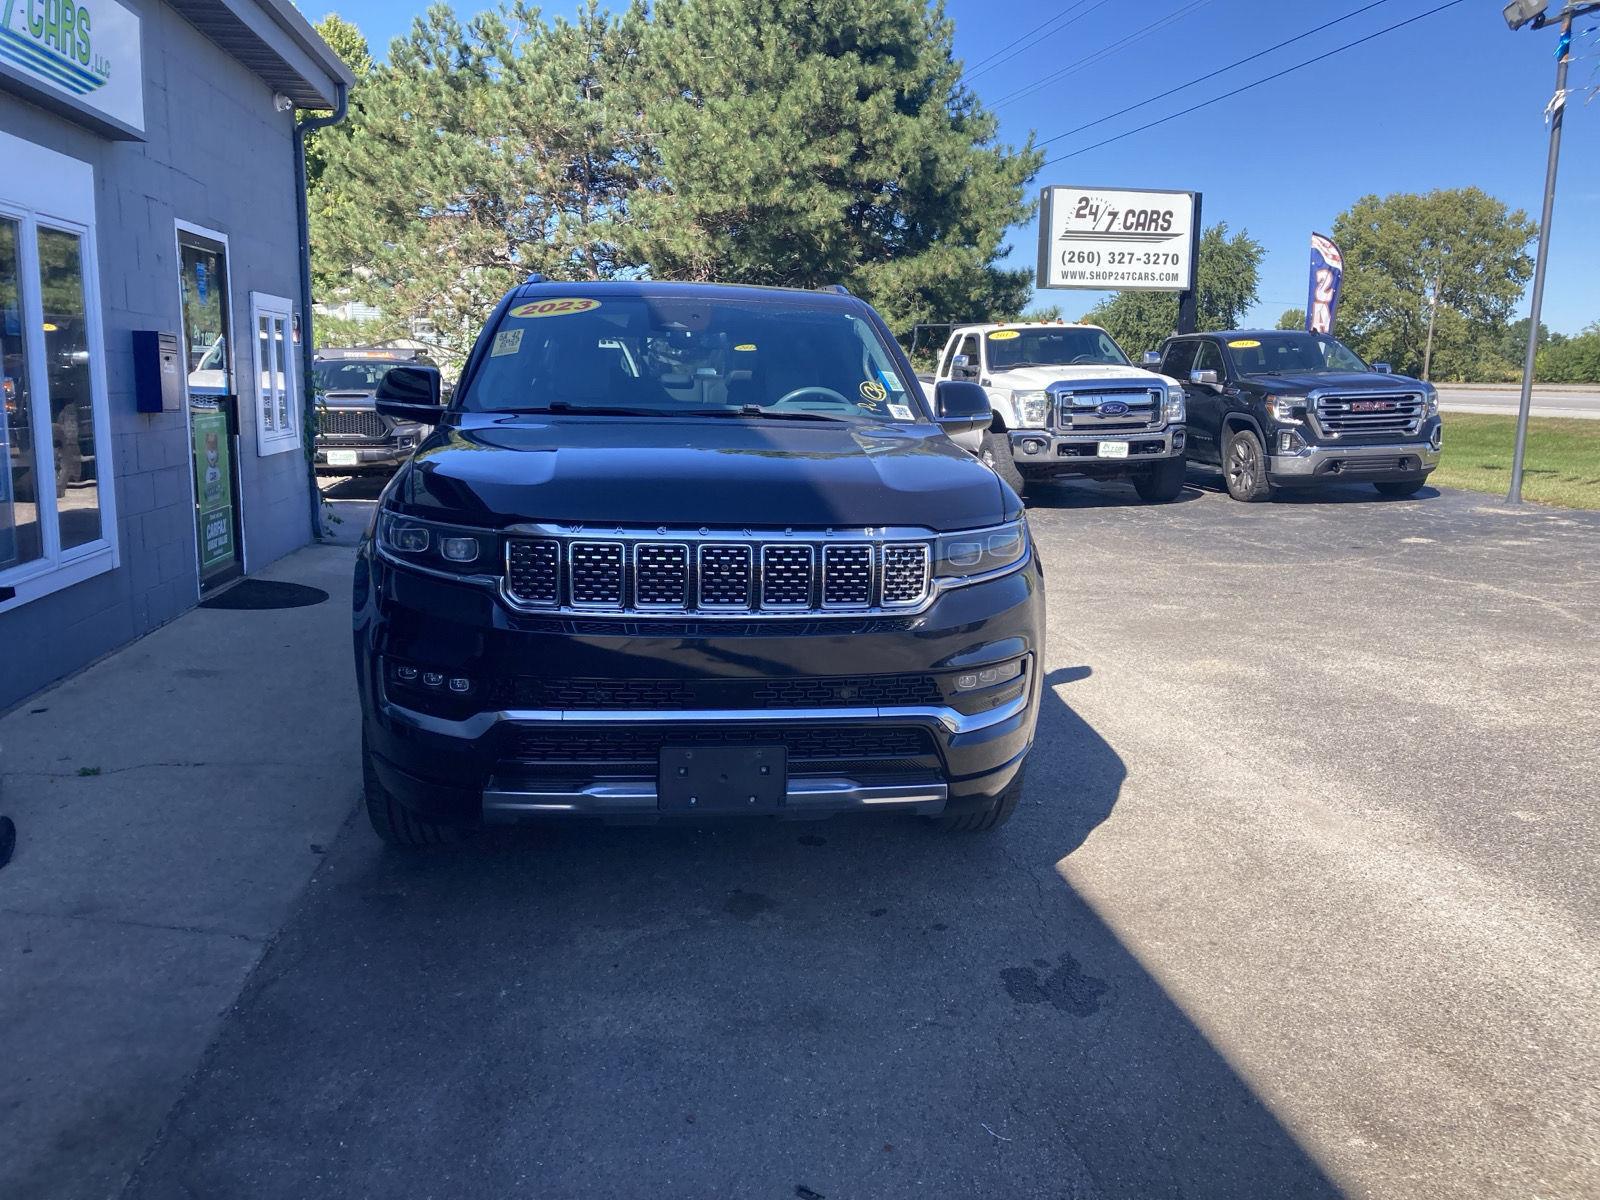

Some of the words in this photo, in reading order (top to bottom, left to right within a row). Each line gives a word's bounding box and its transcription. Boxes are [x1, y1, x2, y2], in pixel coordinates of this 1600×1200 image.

[27, 0, 91, 66] CARS
[1122, 209, 1174, 232] CARS
[1061, 250, 1101, 266] (260)
[1108, 251, 1179, 265] 327-3270
[1061, 270, 1179, 282] WWW.SHOP247CARS.COM
[518, 300, 593, 316] 2023
[1352, 401, 1396, 411] GMC
